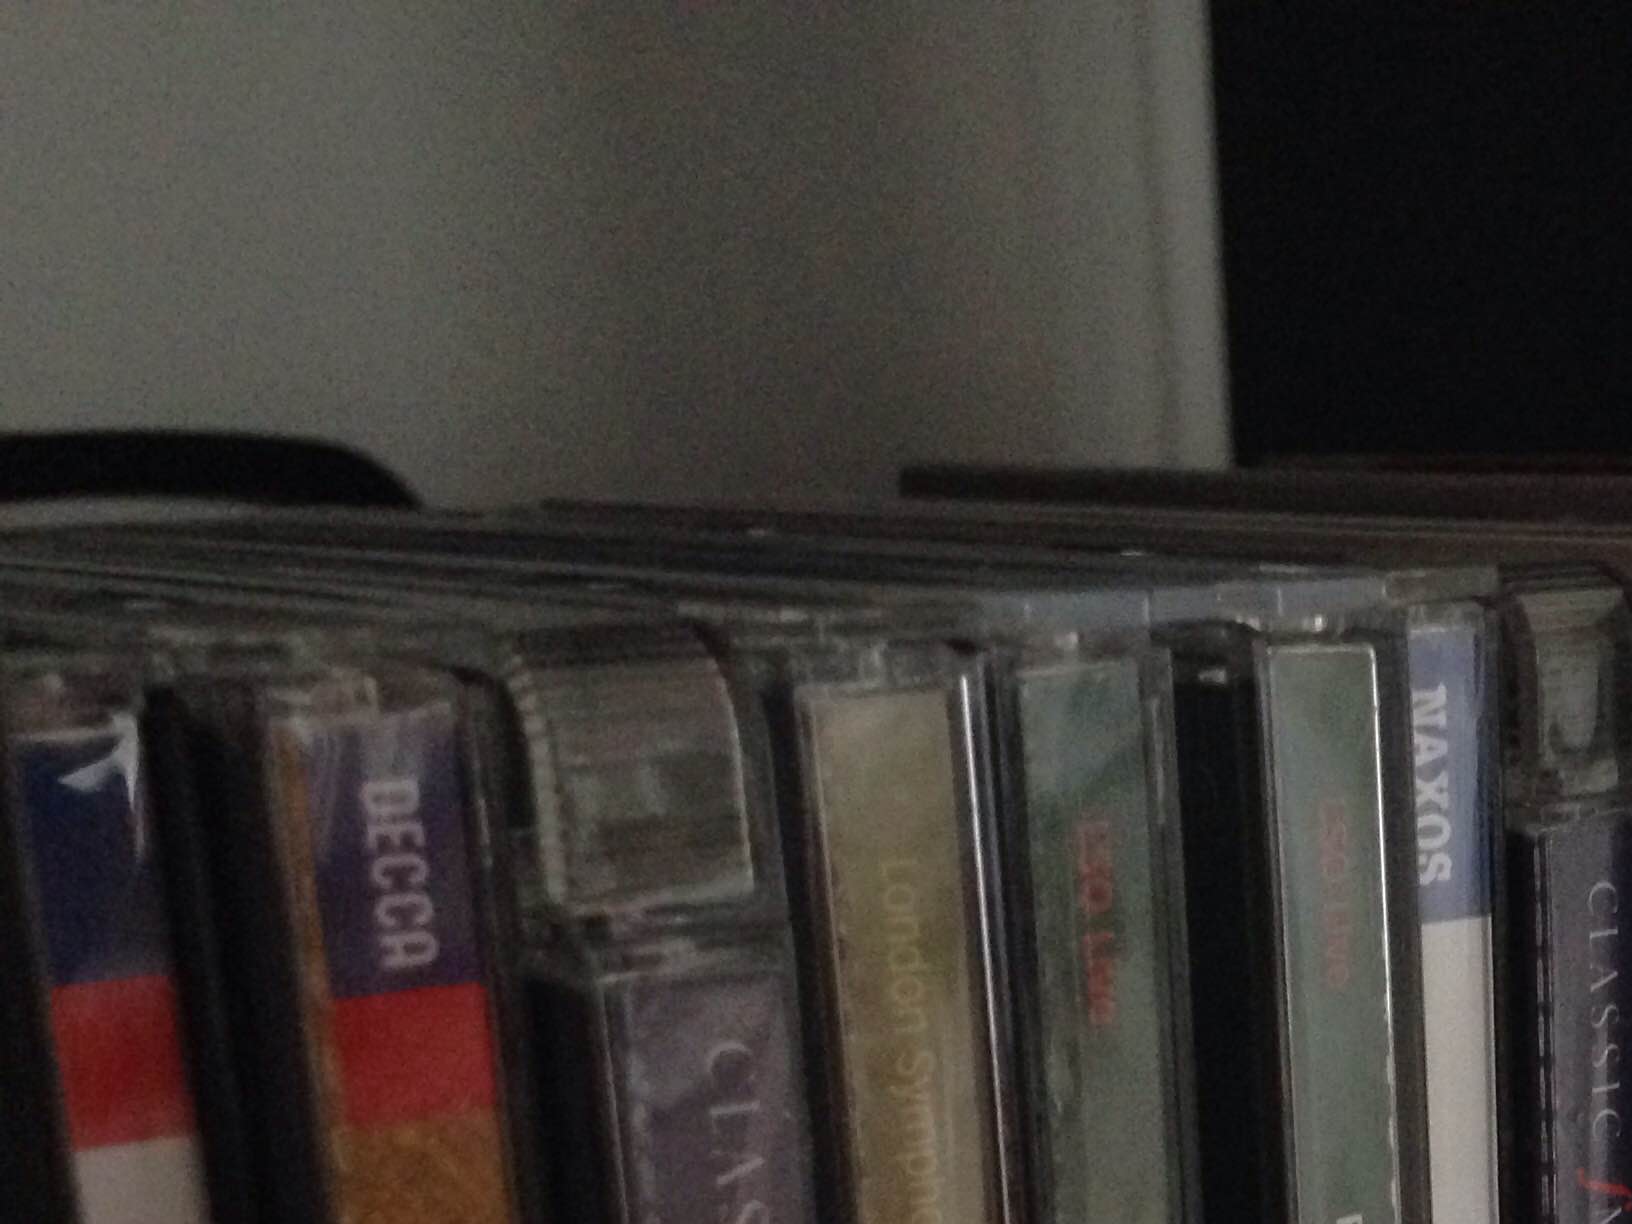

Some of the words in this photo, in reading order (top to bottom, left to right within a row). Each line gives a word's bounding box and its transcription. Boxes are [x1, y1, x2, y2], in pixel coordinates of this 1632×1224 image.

[360, 778, 440, 969] DECCA
[1411, 683, 1452, 886] NAXOS
[882, 860, 931, 1032] London
[1588, 881, 1621, 1142] CLASSIC
